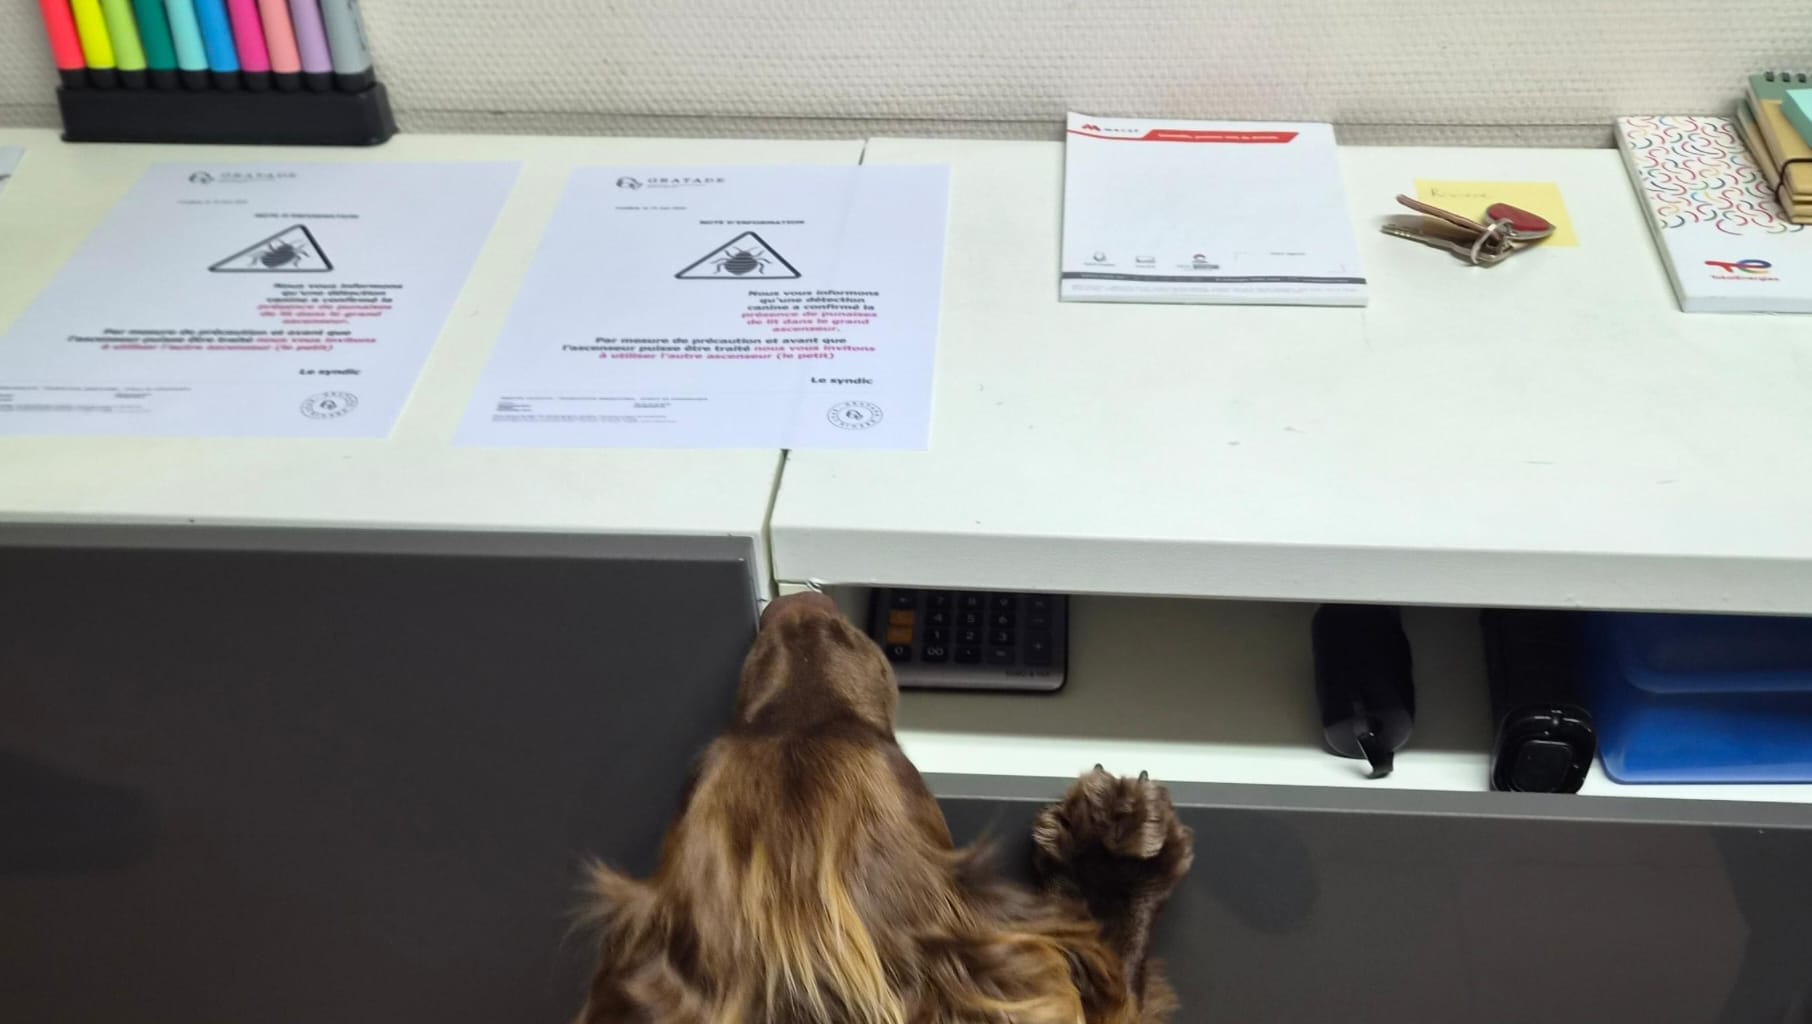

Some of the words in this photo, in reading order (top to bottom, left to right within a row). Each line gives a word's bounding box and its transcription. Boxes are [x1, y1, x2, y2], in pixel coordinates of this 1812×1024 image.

[299, 368, 315, 376] Le
[318, 368, 361, 376] syndic
[811, 377, 826, 385] Le
[830, 377, 873, 385] syndic
[934, 614, 943, 622] 4
[967, 614, 976, 623] 5
[998, 615, 1008, 624] 6
[966, 632, 975, 640] 2
[999, 633, 1007, 641] 3
[927, 647, 944, 656] 00
